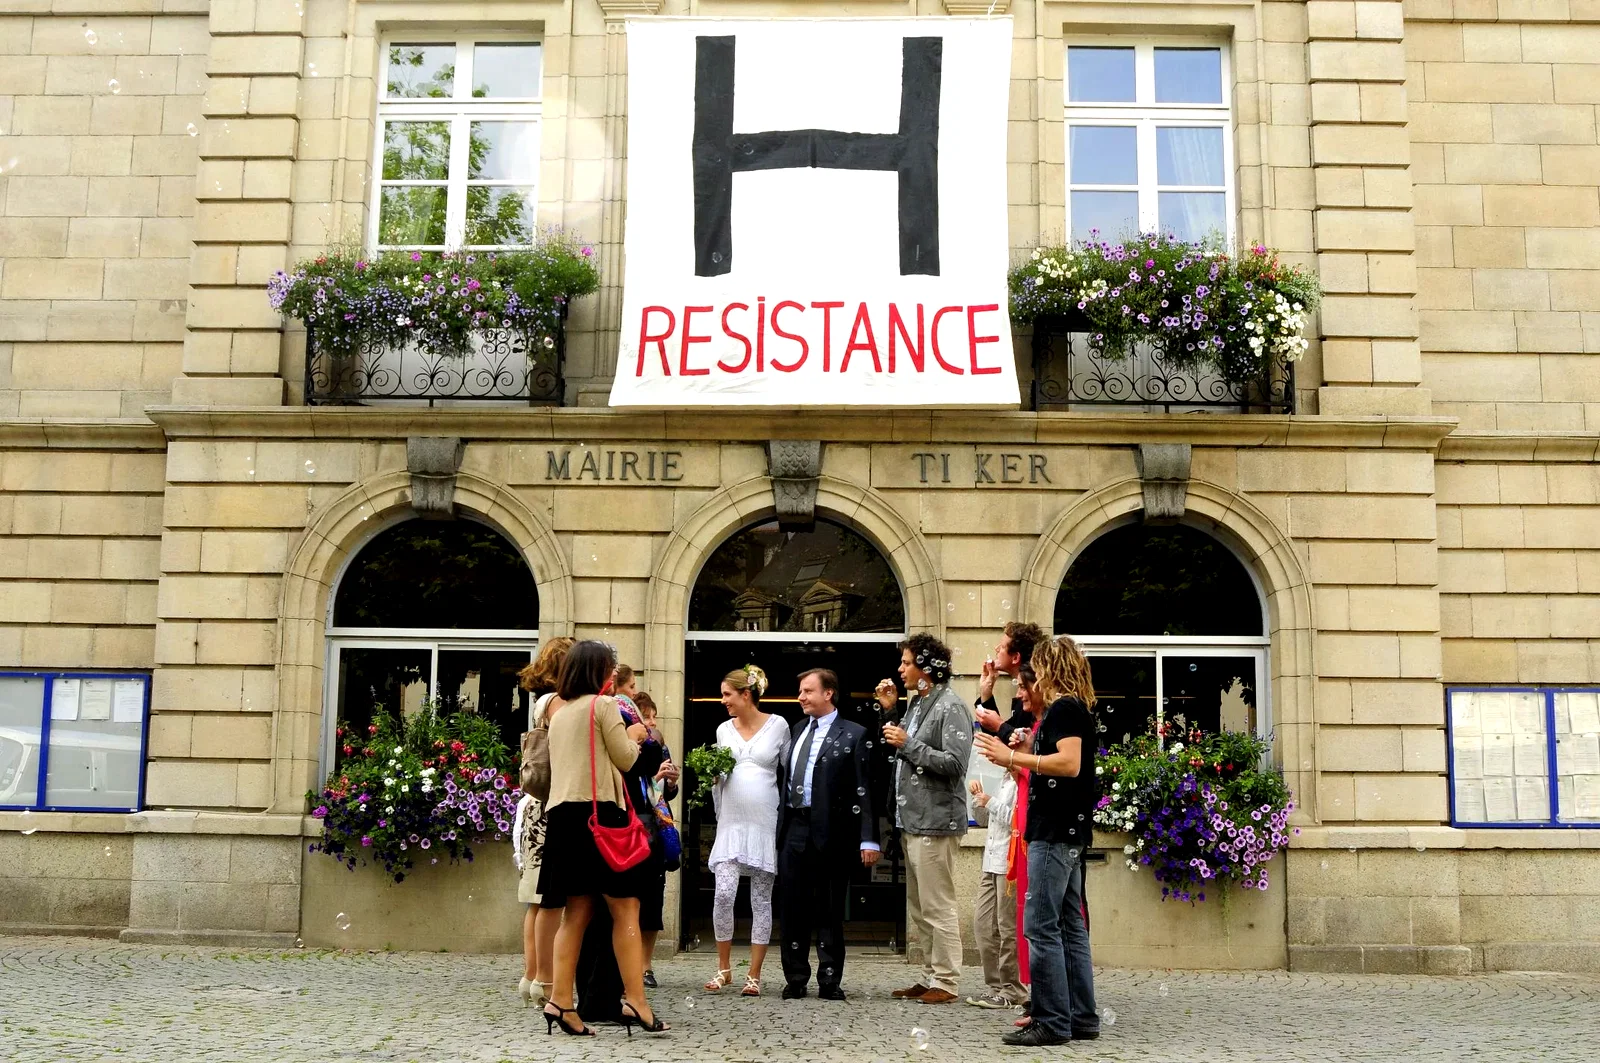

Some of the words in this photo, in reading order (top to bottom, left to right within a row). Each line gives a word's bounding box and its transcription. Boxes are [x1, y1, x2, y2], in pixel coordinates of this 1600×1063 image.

[692, 35, 943, 277] H
[544, 450, 684, 481] MAIRIE
[911, 453, 951, 483] TI
[975, 453, 1052, 484] KER
